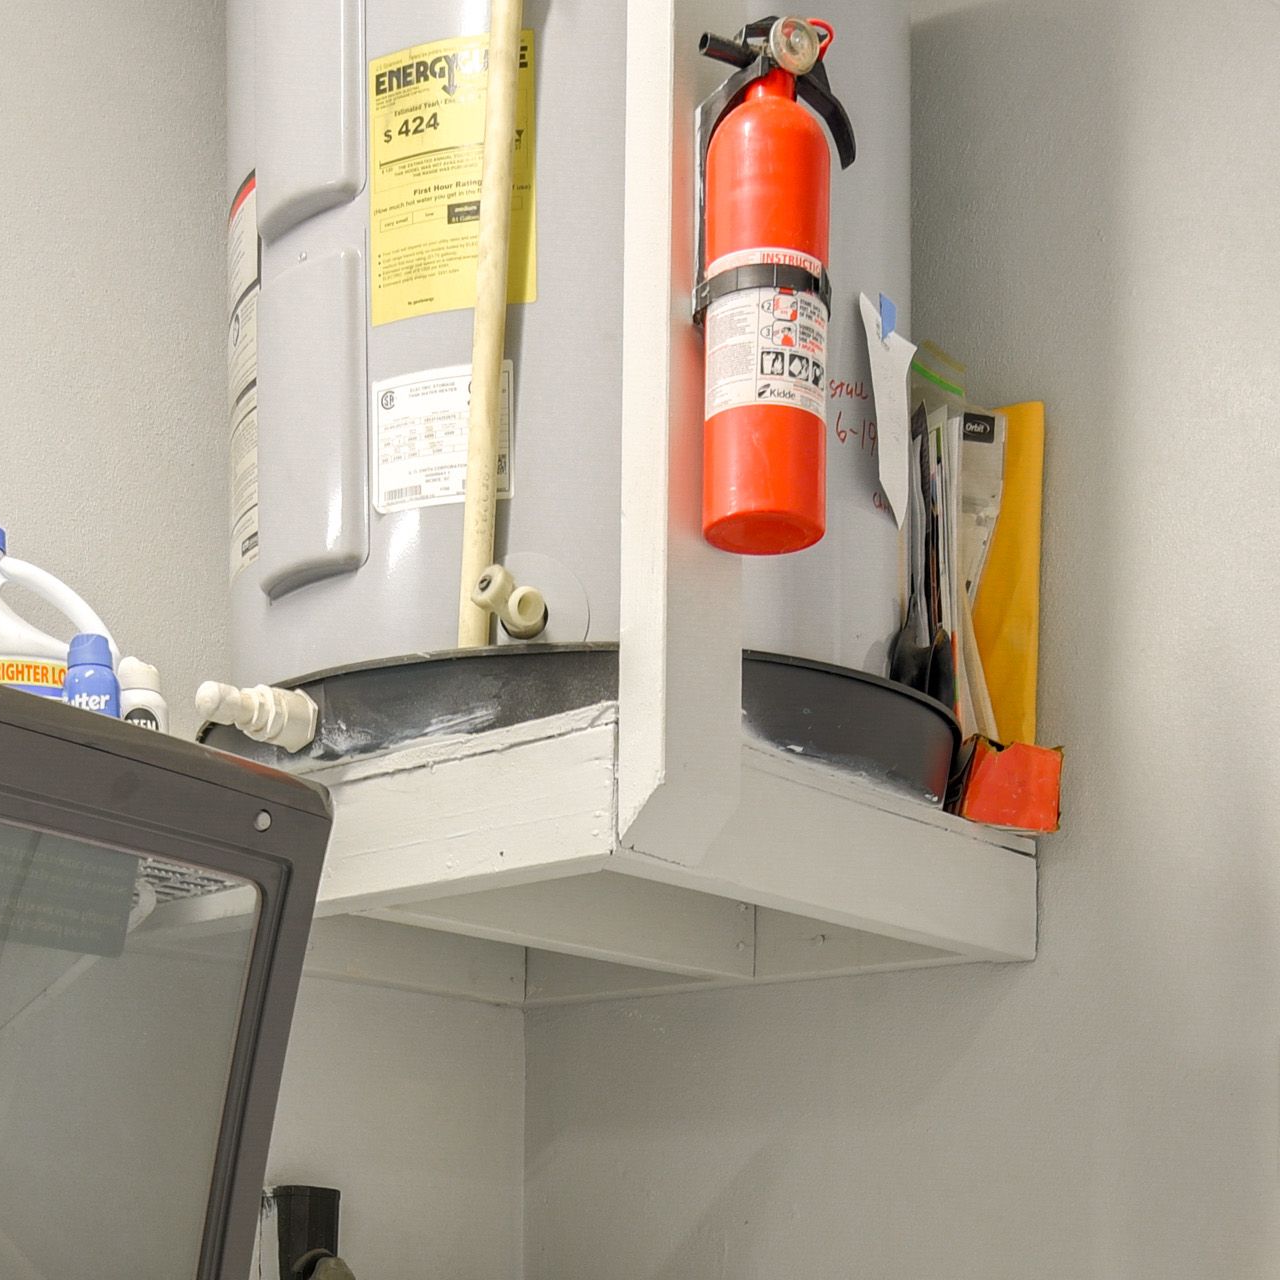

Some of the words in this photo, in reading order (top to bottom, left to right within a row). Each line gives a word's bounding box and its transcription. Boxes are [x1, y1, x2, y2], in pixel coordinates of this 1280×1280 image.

[398, 112, 439, 137] 424
[413, 186, 431, 196] First
[433, 183, 454, 192] Hour
[455, 178, 483, 188] Rating
[769, 388, 796, 400] Kidde
[965, 422, 985, 434] Orbit
